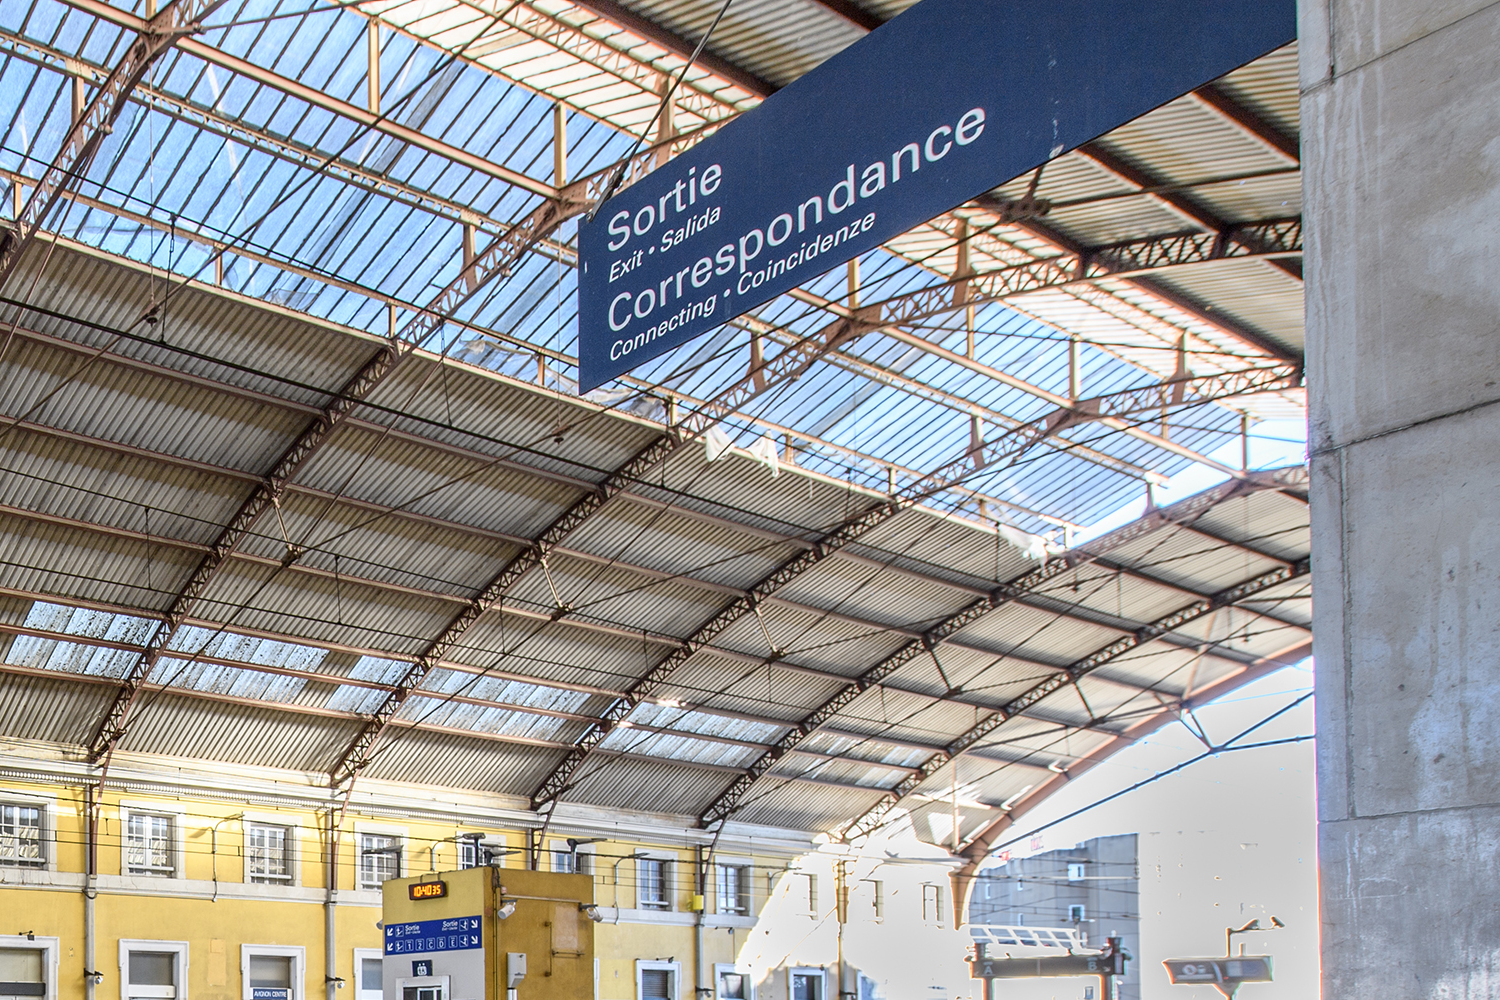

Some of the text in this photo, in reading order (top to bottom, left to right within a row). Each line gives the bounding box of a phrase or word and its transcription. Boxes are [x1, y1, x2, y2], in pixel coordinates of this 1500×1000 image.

[607, 164, 722, 252] Sortie
[608, 107, 986, 332] Correspondance
[608, 206, 721, 283] Exit Salida
[610, 212, 876, 361] Connecting Coincidenze
[432, 884, 441, 895] 35
[442, 920, 458, 928] Sortie
[254, 990, 287, 998] AVIGNON CENTRE
